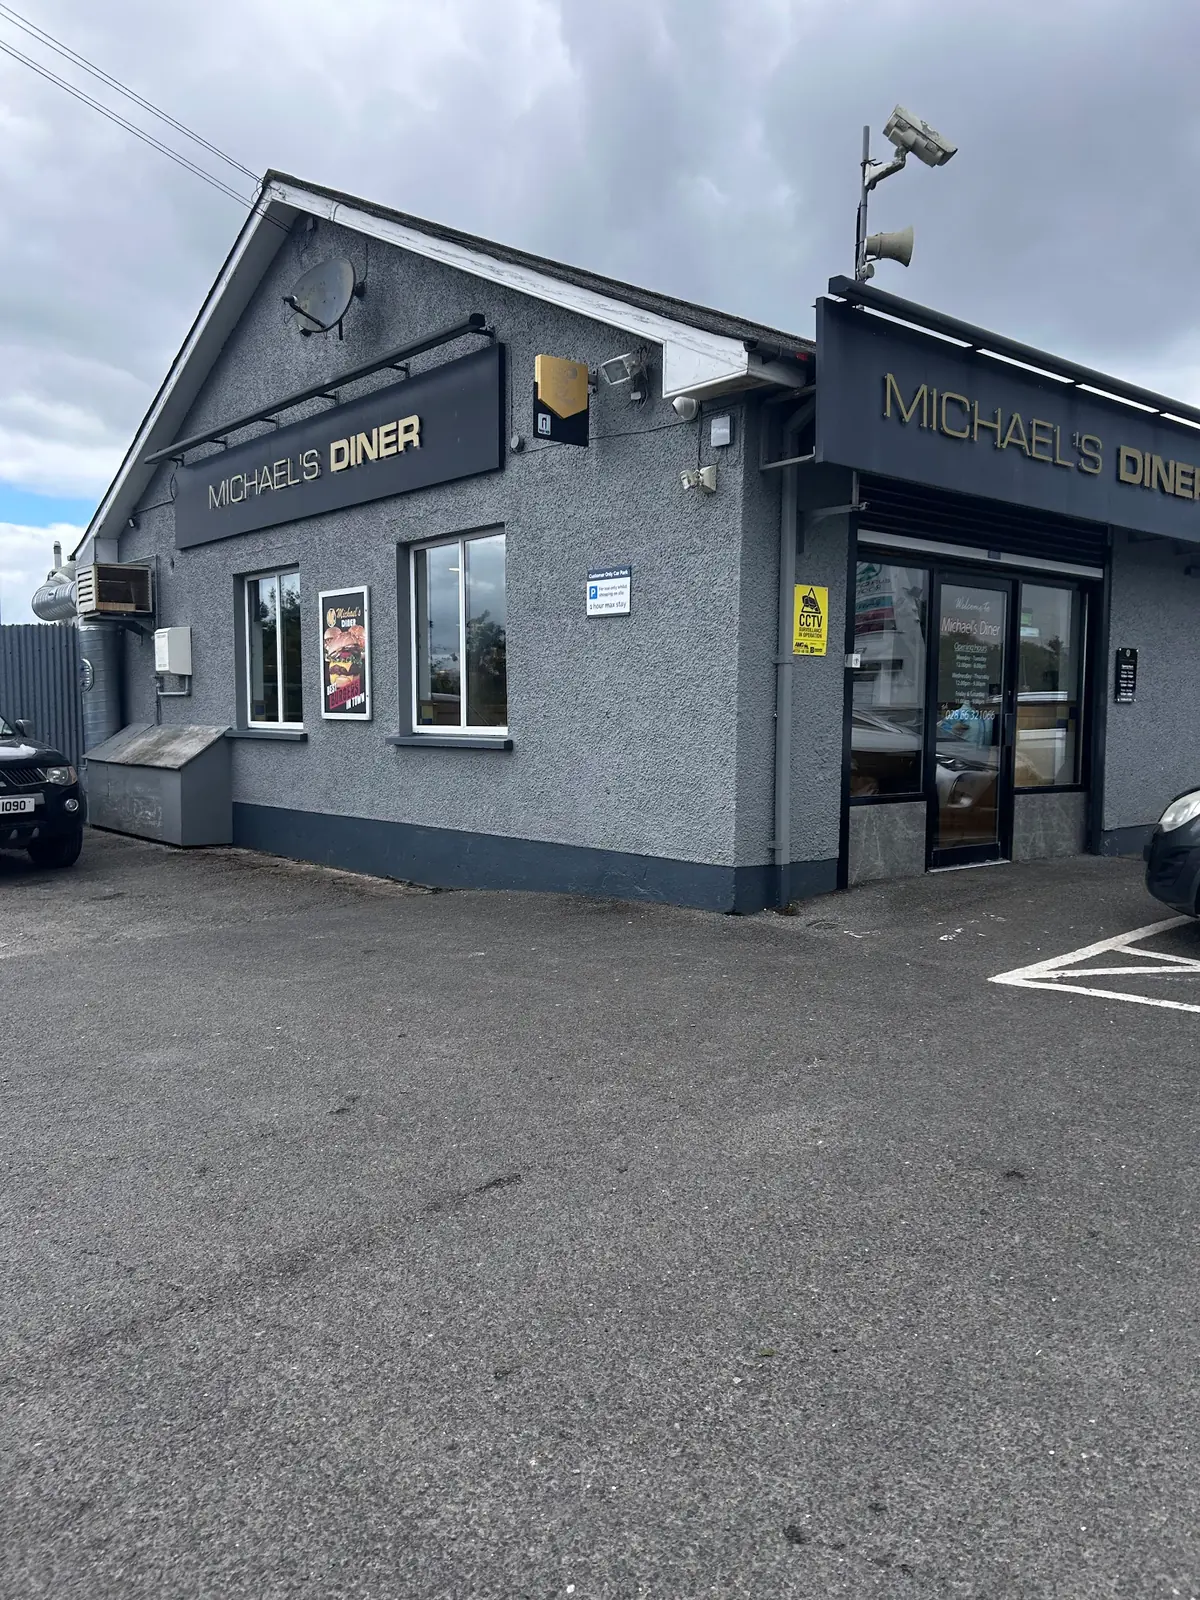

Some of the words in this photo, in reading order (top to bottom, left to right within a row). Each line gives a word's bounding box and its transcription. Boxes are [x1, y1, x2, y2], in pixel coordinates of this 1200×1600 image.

[886, 372, 1102, 474] MICHAEL'S
[1119, 445, 1200, 500] DINE
[209, 449, 320, 509] MICHAEL'S
[330, 415, 420, 472] DINER
[799, 613, 823, 628] CCTV
[941, 616, 978, 634] Michael's
[979, 620, 1000, 636] Diner
[945, 709, 959, 720] 028
[970, 709, 996, 721] 321066
